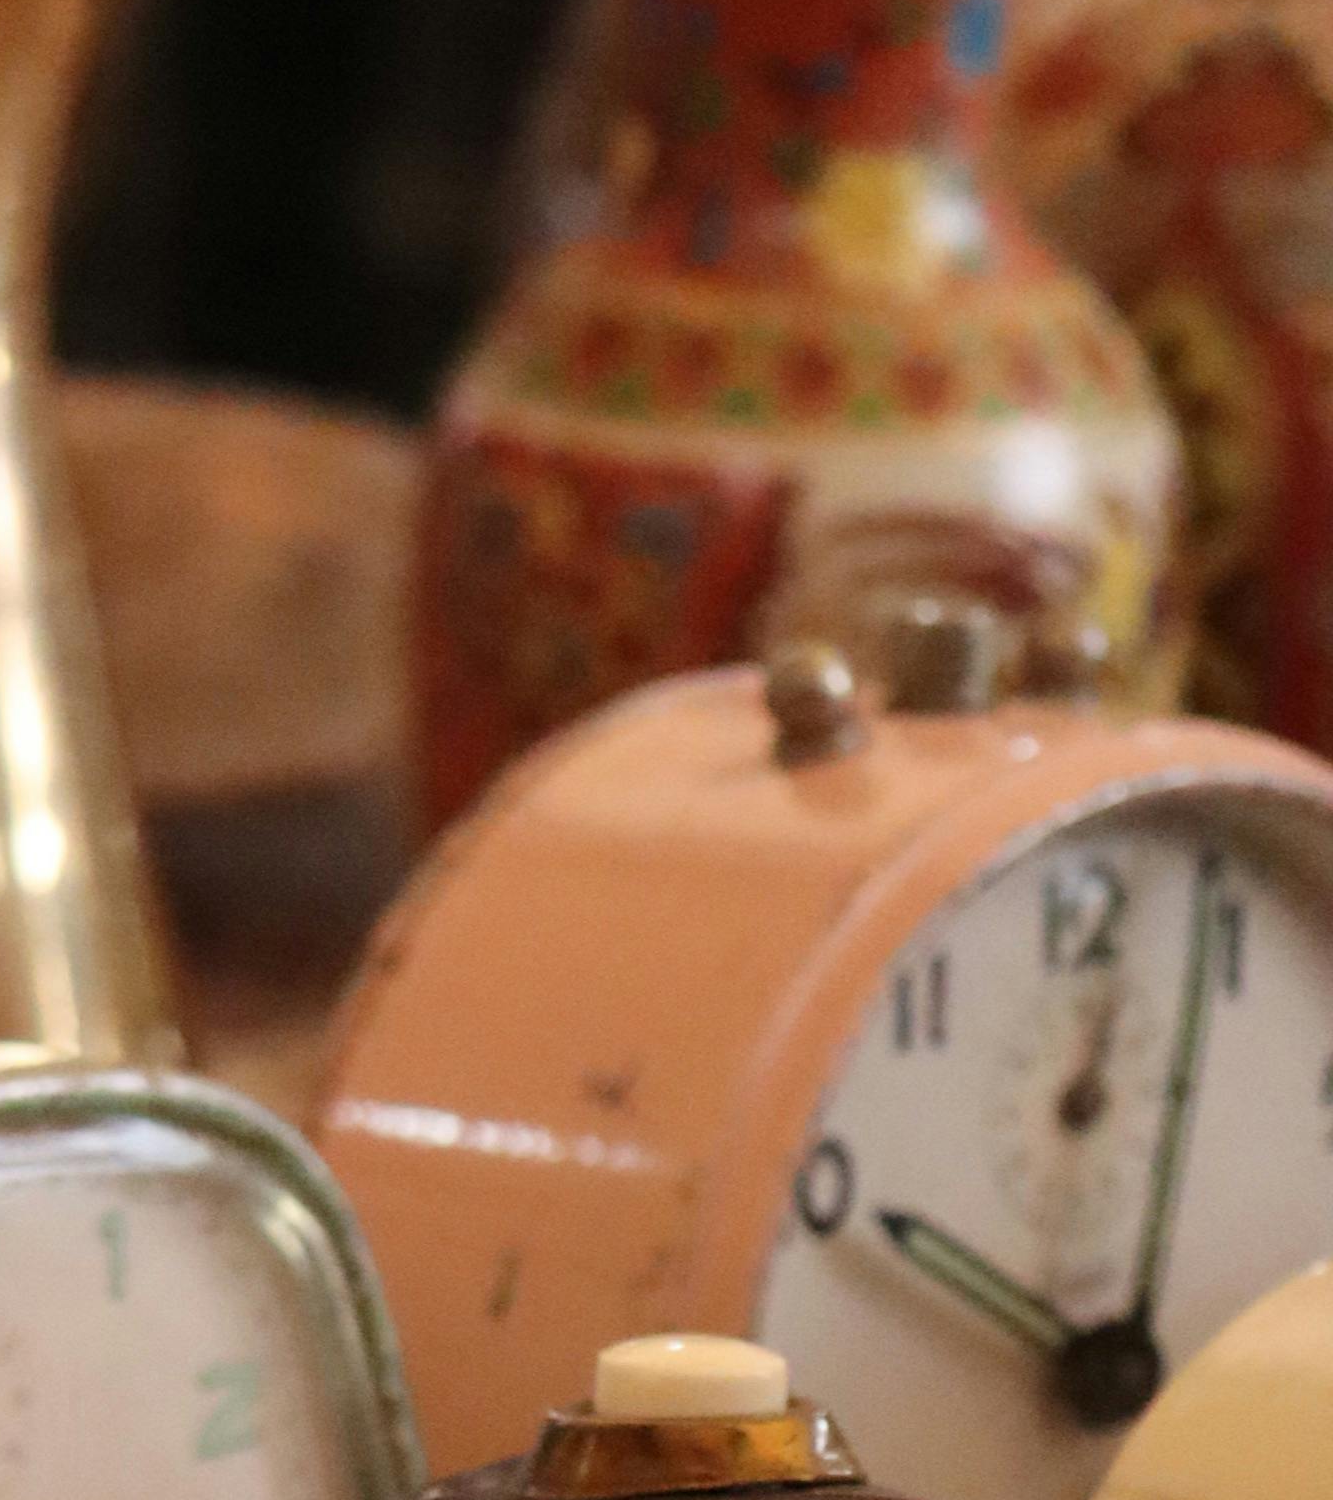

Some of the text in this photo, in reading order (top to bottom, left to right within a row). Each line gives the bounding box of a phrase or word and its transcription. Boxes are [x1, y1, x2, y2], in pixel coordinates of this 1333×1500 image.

[1043, 860, 1125, 973] 12
[891, 955, 947, 1050] 11
[795, 1137, 855, 1236] 0
[100, 1211, 126, 1297] 1
